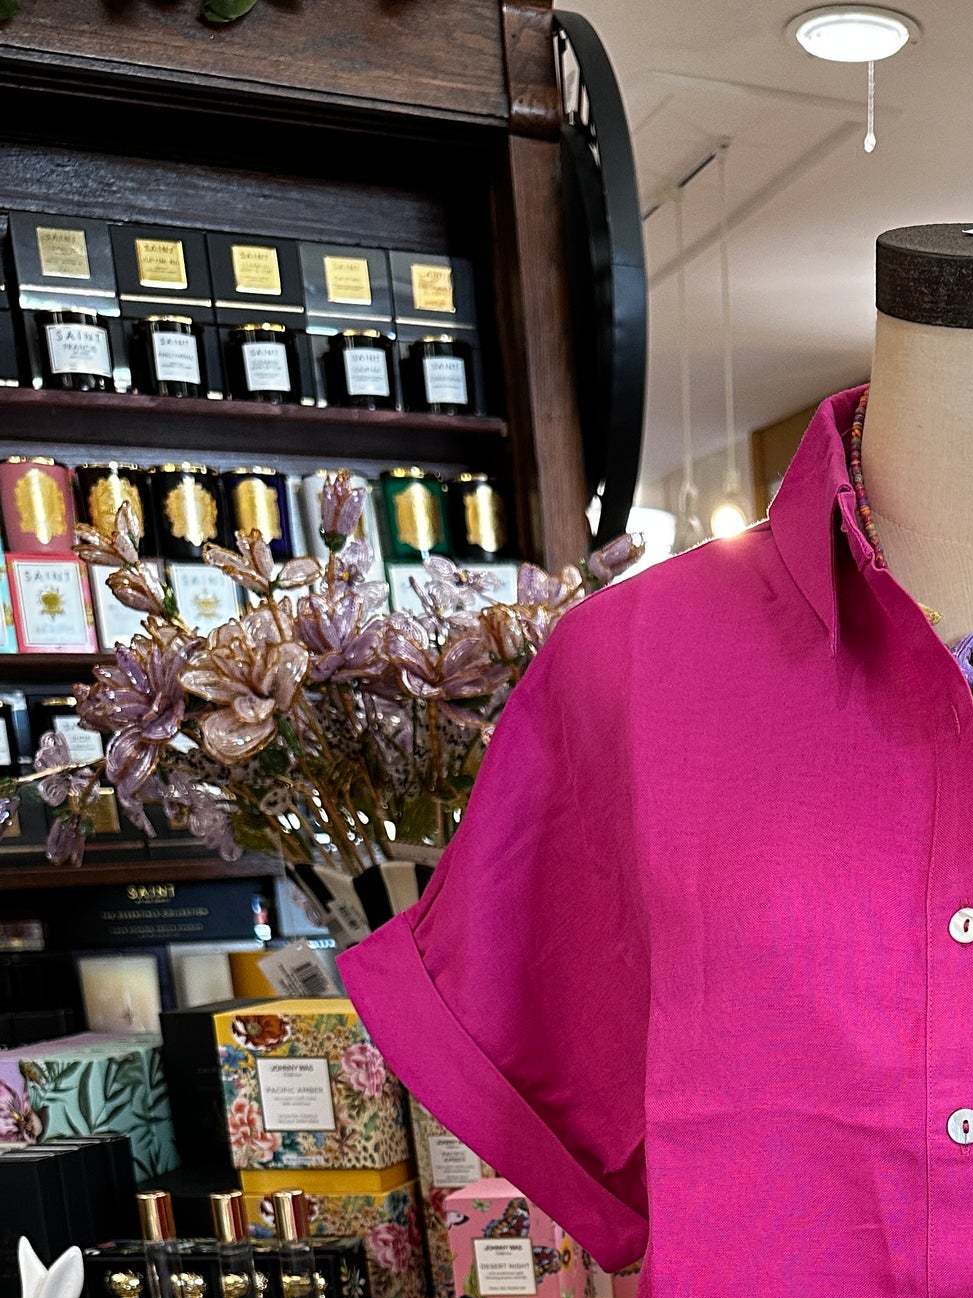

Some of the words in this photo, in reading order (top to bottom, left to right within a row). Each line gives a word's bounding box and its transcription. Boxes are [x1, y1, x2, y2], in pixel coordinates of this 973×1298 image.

[55, 329, 101, 344] SAINT
[24, 571, 72, 583] SAINT
[127, 883, 176, 900] SAINT
